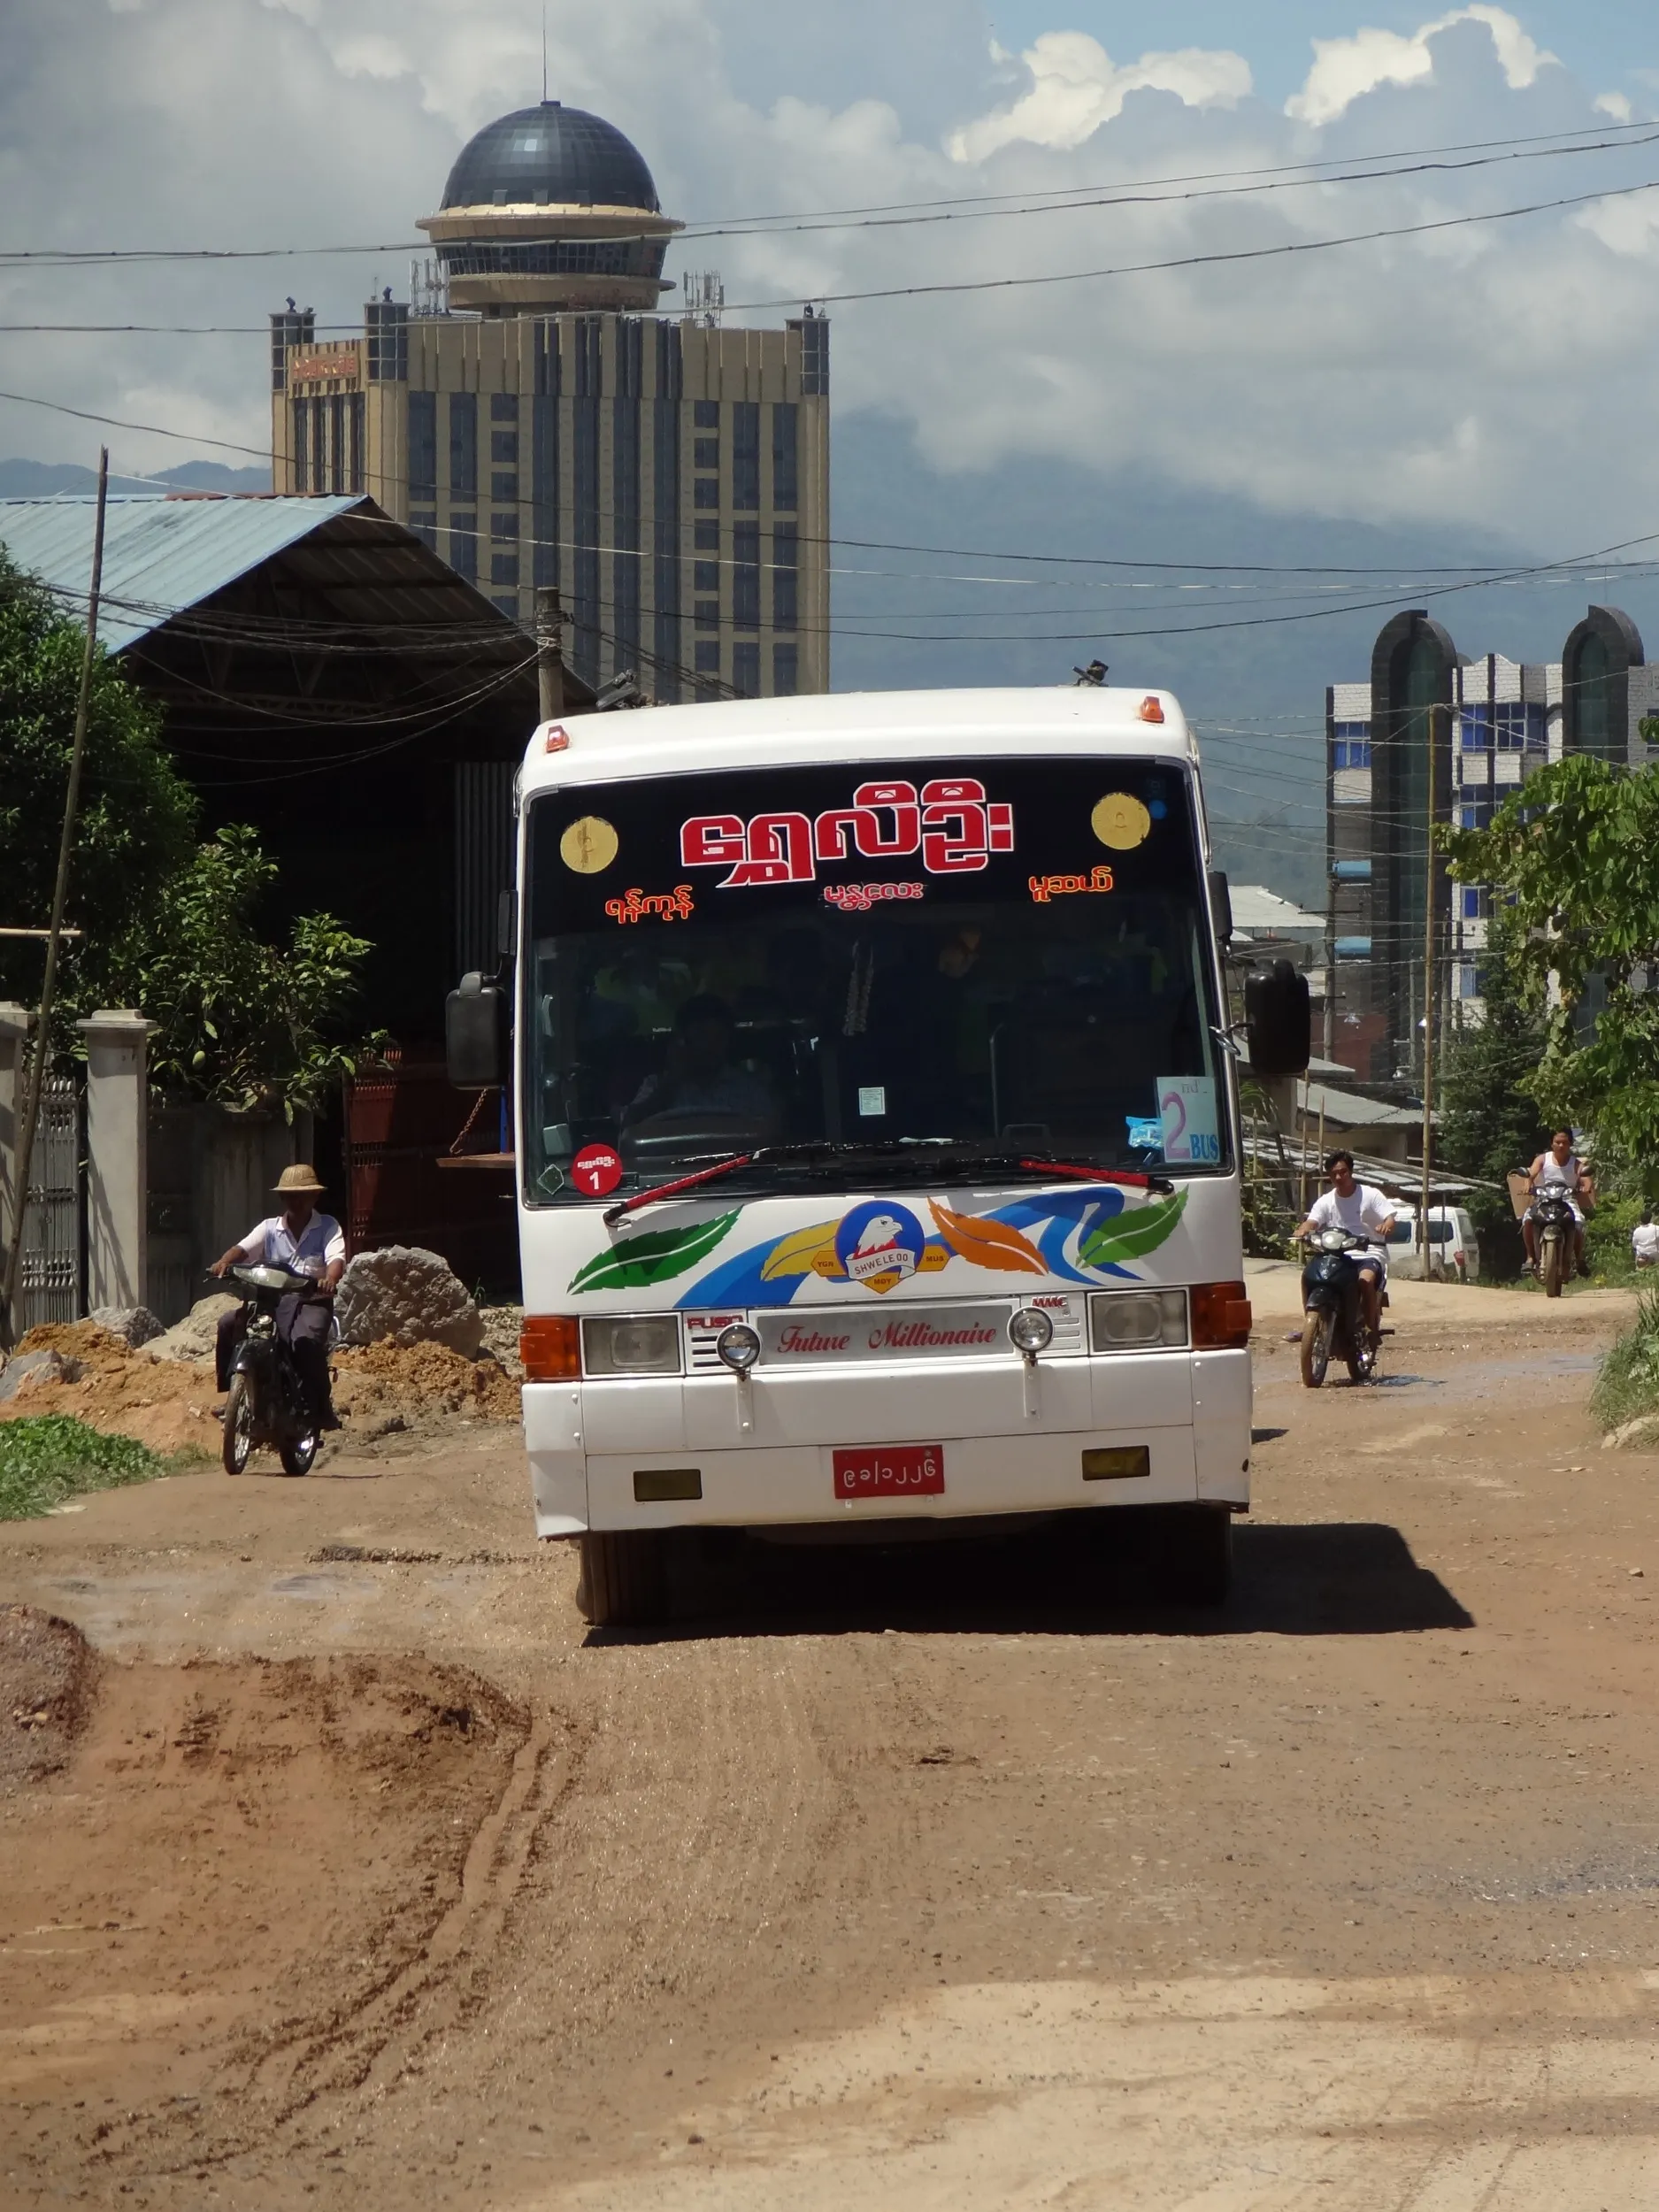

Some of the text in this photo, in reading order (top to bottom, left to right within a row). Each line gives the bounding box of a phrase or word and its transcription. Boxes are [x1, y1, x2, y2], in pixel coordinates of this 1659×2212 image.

[824, 883, 924, 910] မန္တလေး
[1029, 866, 1112, 902] မူဆယ်
[605, 885, 694, 924] ရန်ကုန်
[1189, 1133, 1218, 1160] BUS
[589, 1171, 599, 1190] 1
[854, 1257, 882, 1275] SHWE
[1031, 1295, 1068, 1308] MMC
[778, 1321, 996, 1353] Future Millionaire
